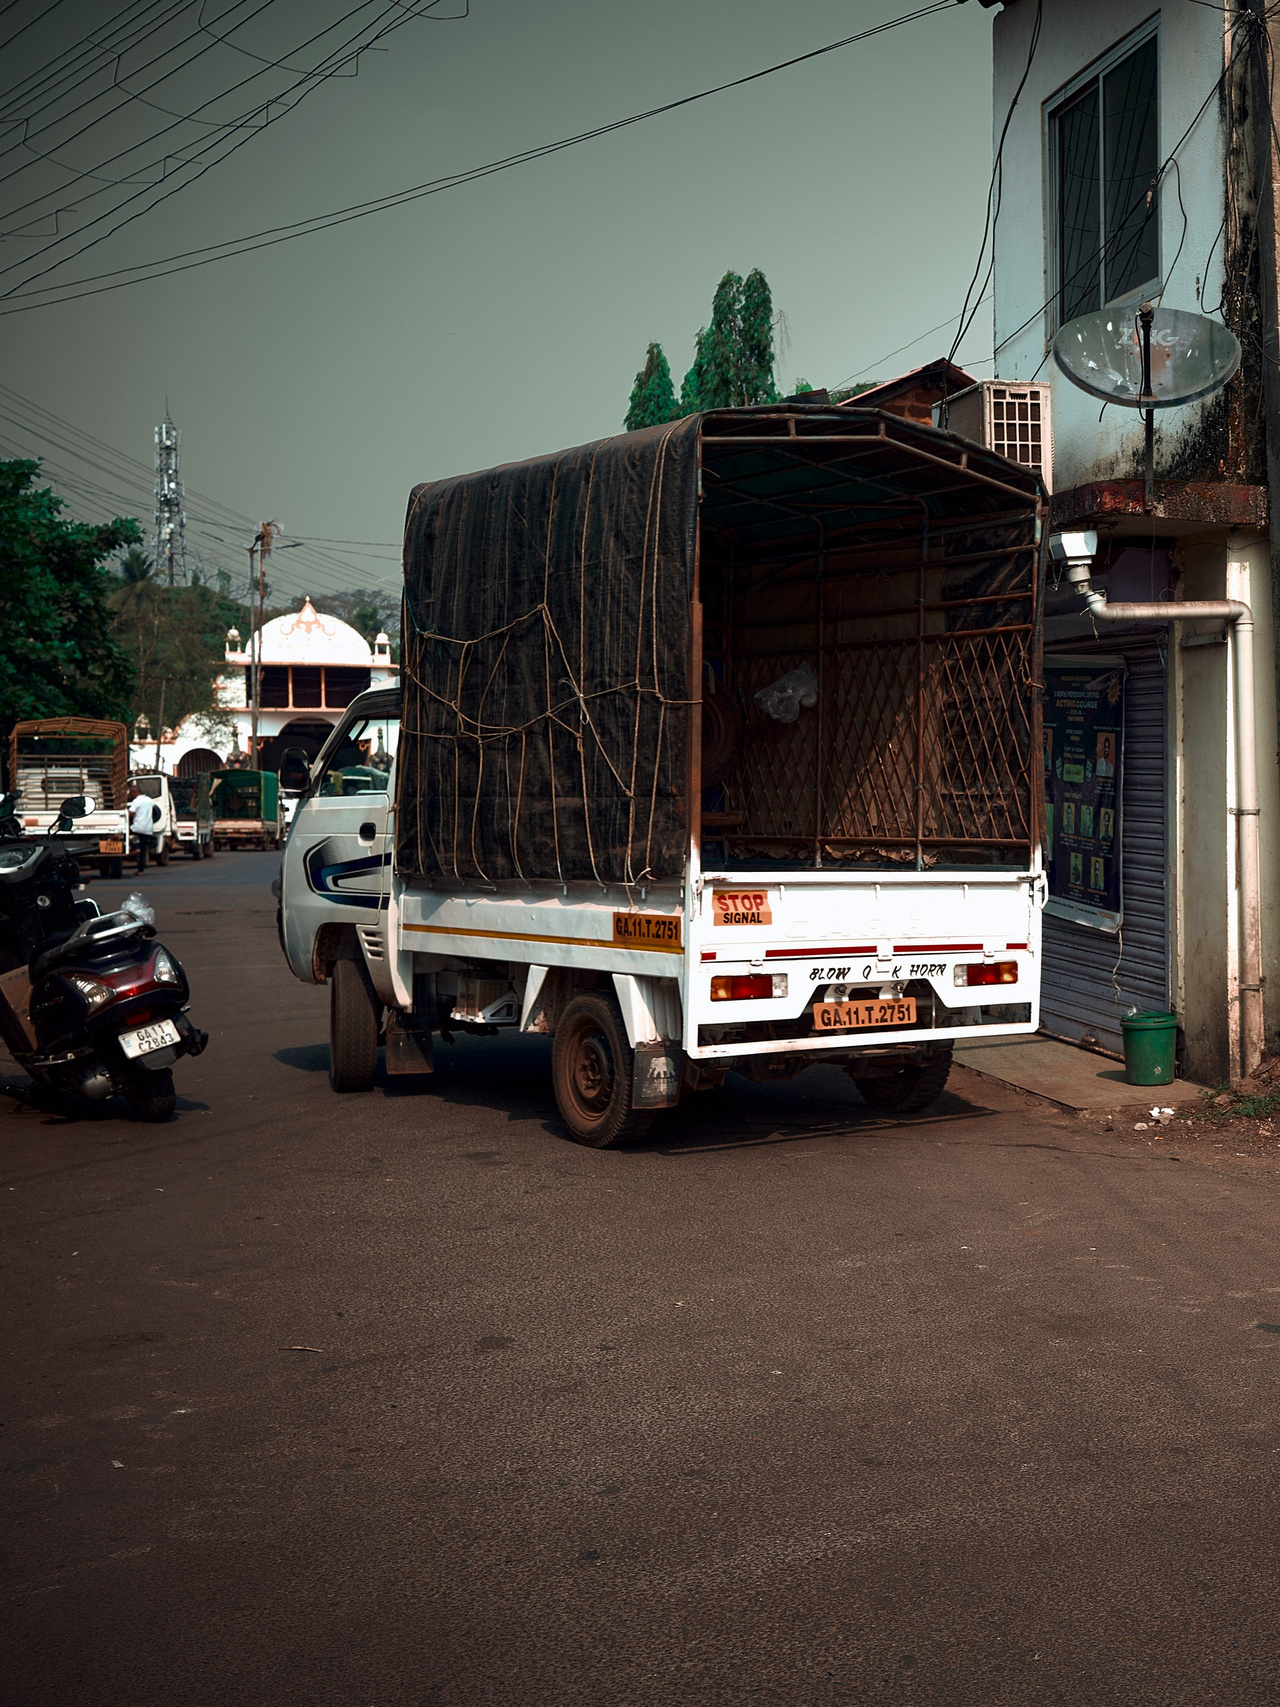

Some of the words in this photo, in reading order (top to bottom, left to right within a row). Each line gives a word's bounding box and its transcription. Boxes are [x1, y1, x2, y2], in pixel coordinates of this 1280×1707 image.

[1076, 700, 1098, 709] COURSE
[717, 894, 764, 912] STOP
[723, 912, 762, 924] SIGNAL
[616, 917, 678, 940] GA.11.T.2751
[809, 967, 851, 981] BLOW
[909, 963, 947, 977] HORN
[821, 1003, 911, 1026] GA.11.T.2751
[136, 1024, 165, 1041] GA11
